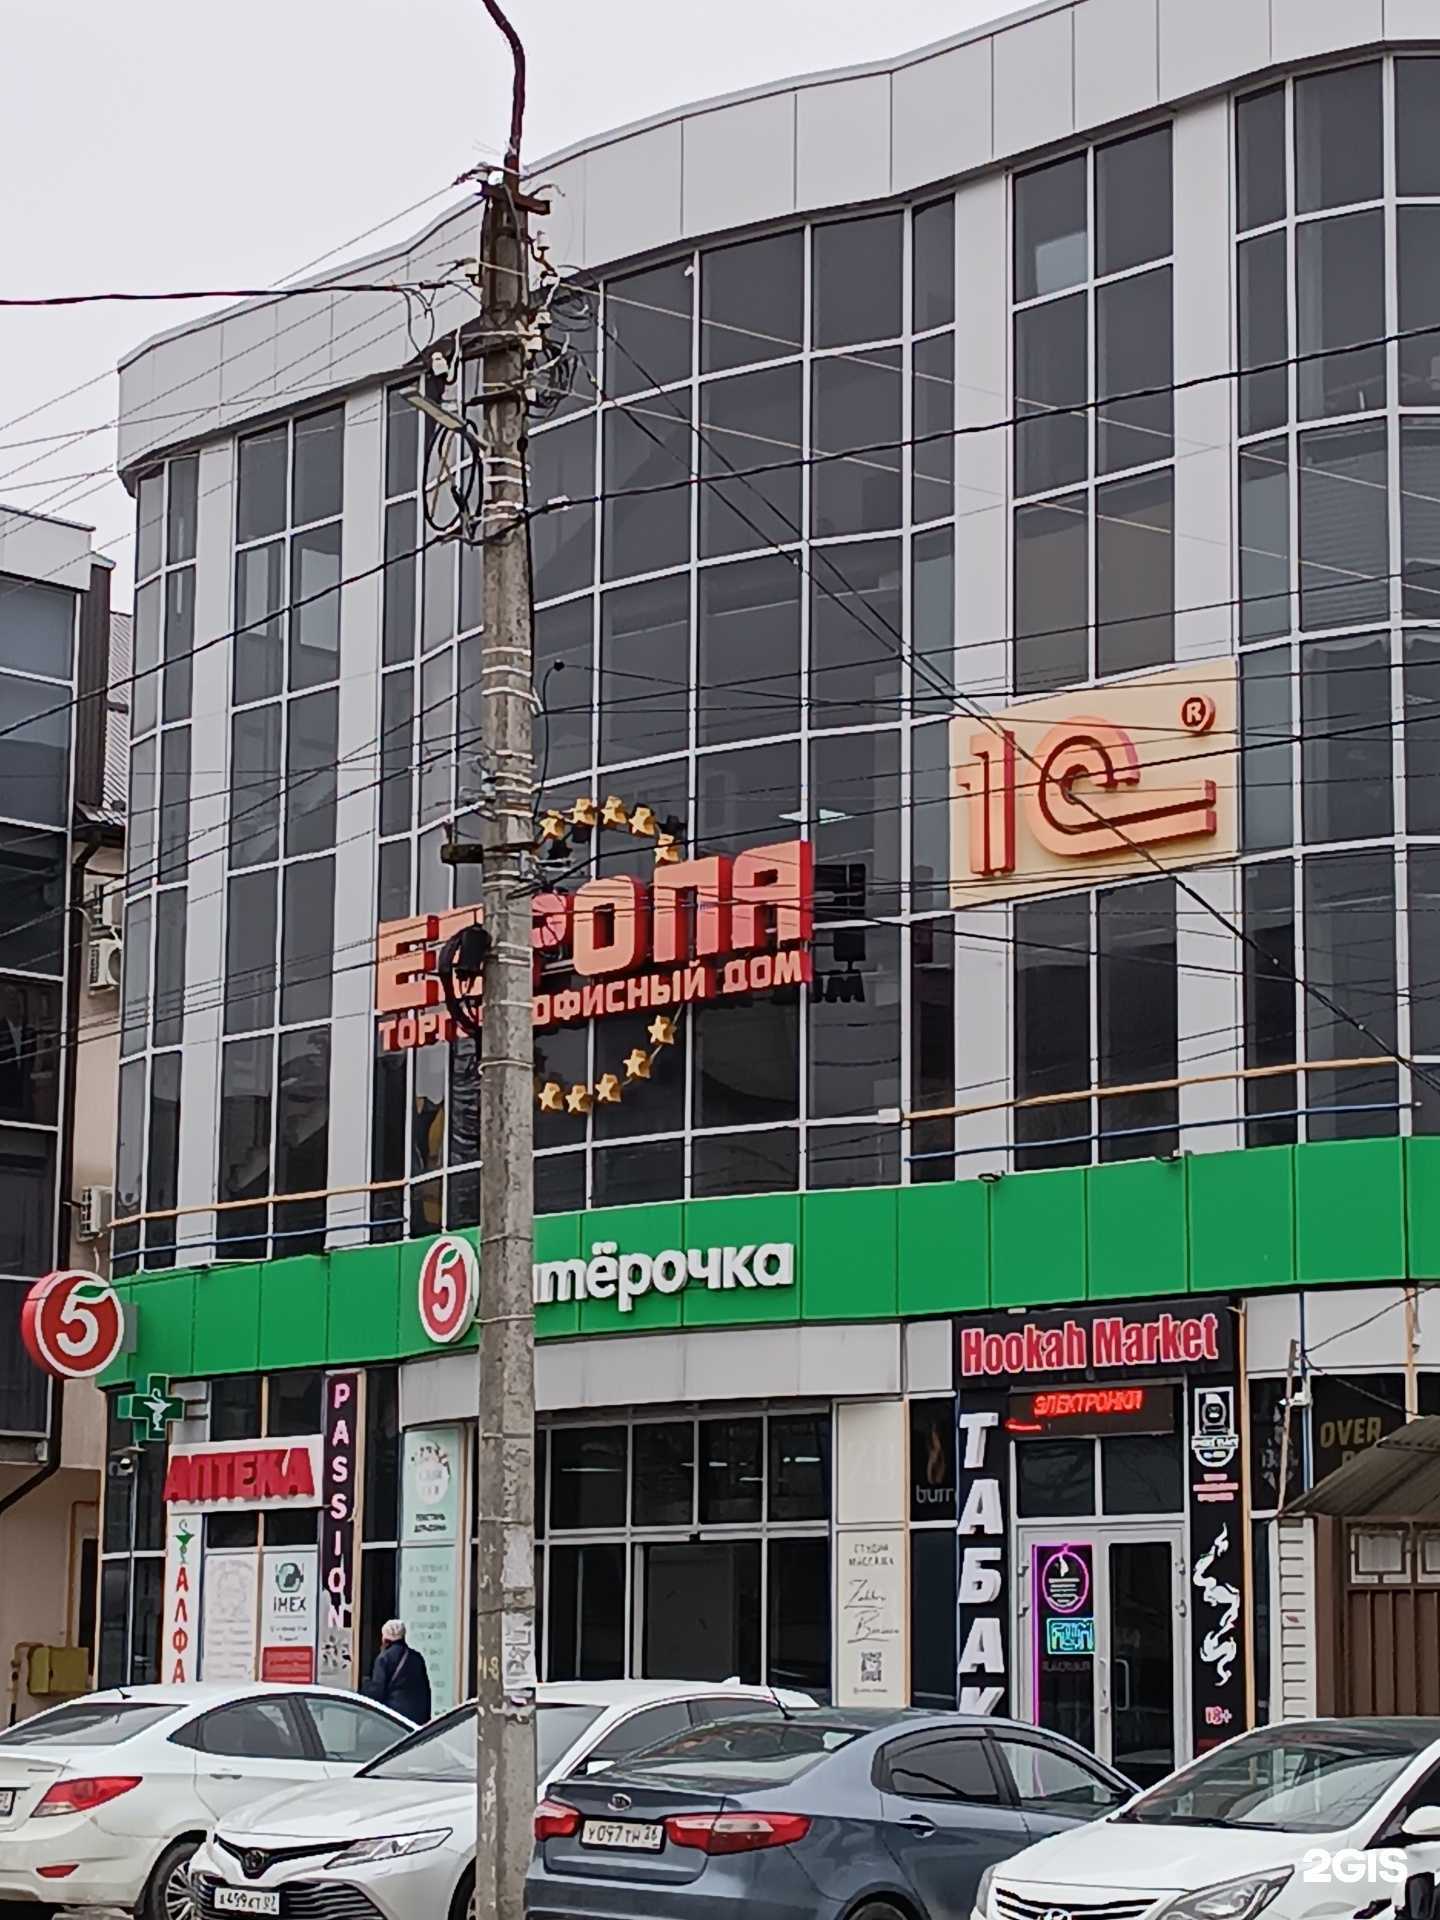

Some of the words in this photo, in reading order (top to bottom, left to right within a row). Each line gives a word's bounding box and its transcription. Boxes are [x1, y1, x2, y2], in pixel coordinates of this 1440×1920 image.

[723, 950, 806, 994] ДОМ
[533, 1241, 794, 1312] тёрочка
[56, 1280, 99, 1357] 5
[962, 1319, 1087, 1376] Hookah
[1093, 1313, 1219, 1367] Market
[1320, 1417, 1382, 1448] OVER
[163, 1448, 315, 1504] АПТЕКА
[327, 1383, 351, 1629] PASSION
